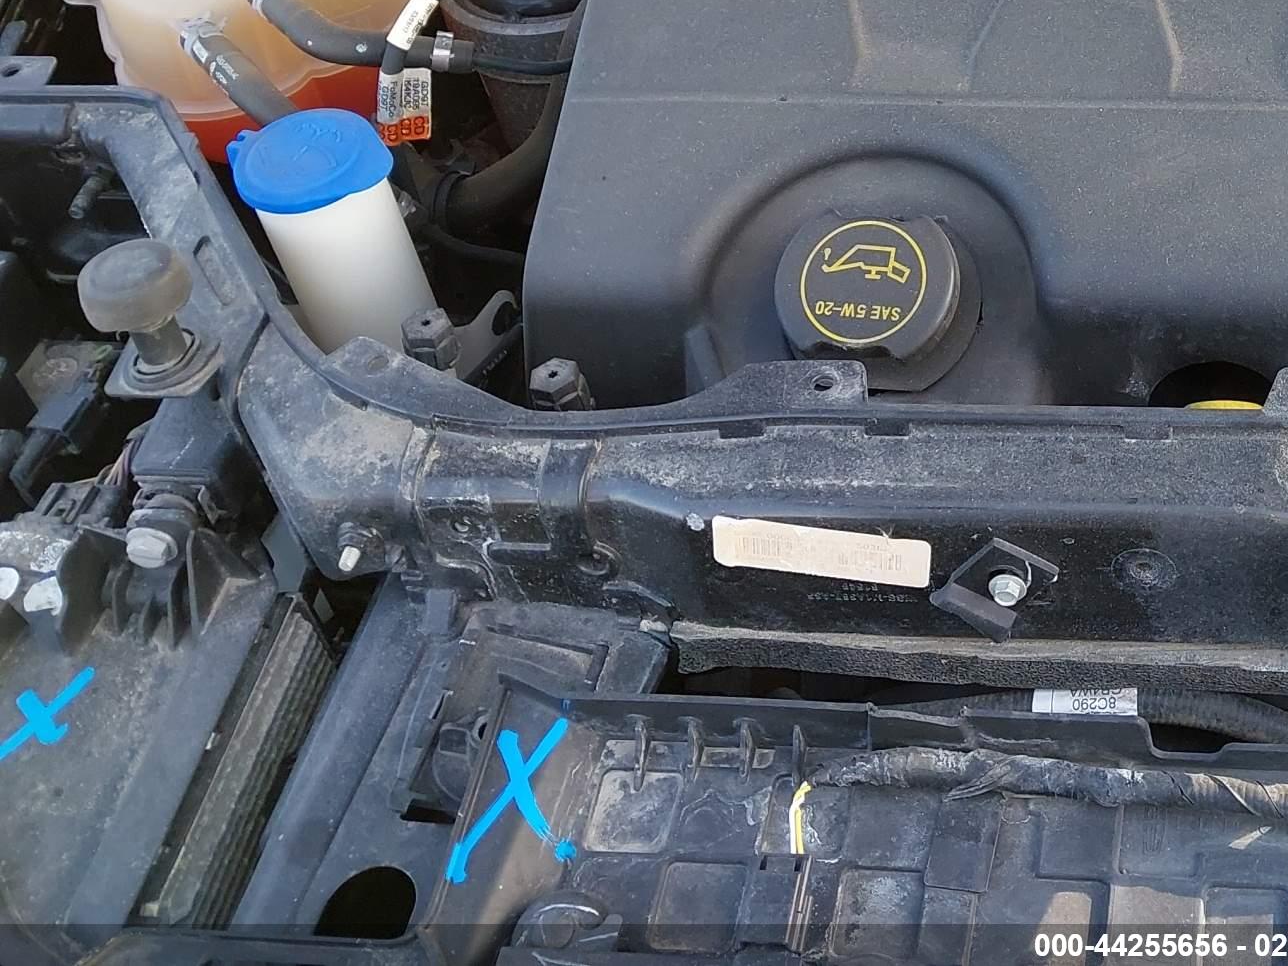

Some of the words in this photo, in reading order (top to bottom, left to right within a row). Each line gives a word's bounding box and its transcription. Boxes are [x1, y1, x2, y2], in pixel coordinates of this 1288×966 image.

[414, 116, 425, 135] CD
[815, 300, 867, 319] 5W-20
[870, 306, 901, 322] SAE
[1072, 696, 1117, 711] 8C290
